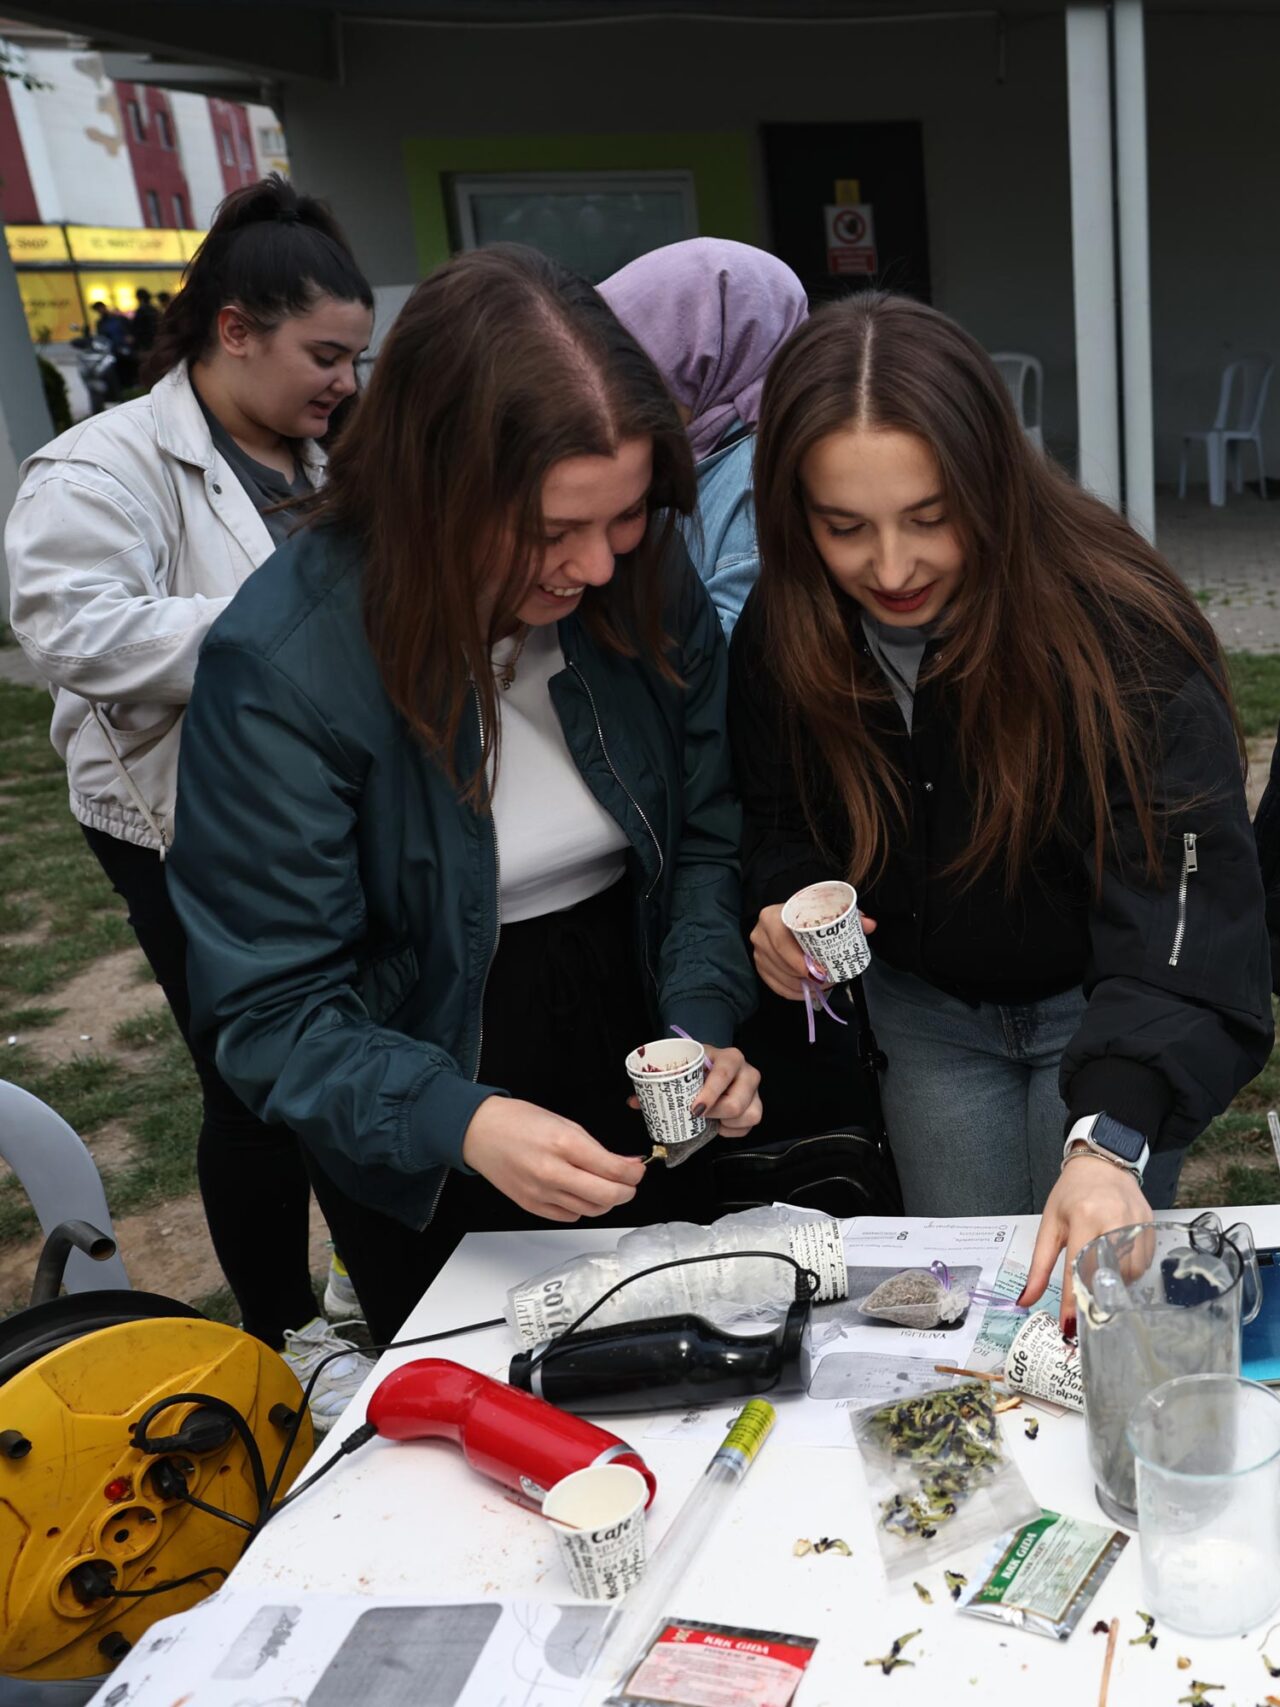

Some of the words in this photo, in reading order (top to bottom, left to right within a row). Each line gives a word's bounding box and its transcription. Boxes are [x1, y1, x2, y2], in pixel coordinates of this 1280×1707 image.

[816, 919, 847, 938] Cafe
[684, 1066, 703, 1083] Caf
[1038, 1315, 1058, 1332] coff
[1008, 1350, 1028, 1384] Cafe
[1055, 1361, 1082, 1381] coff
